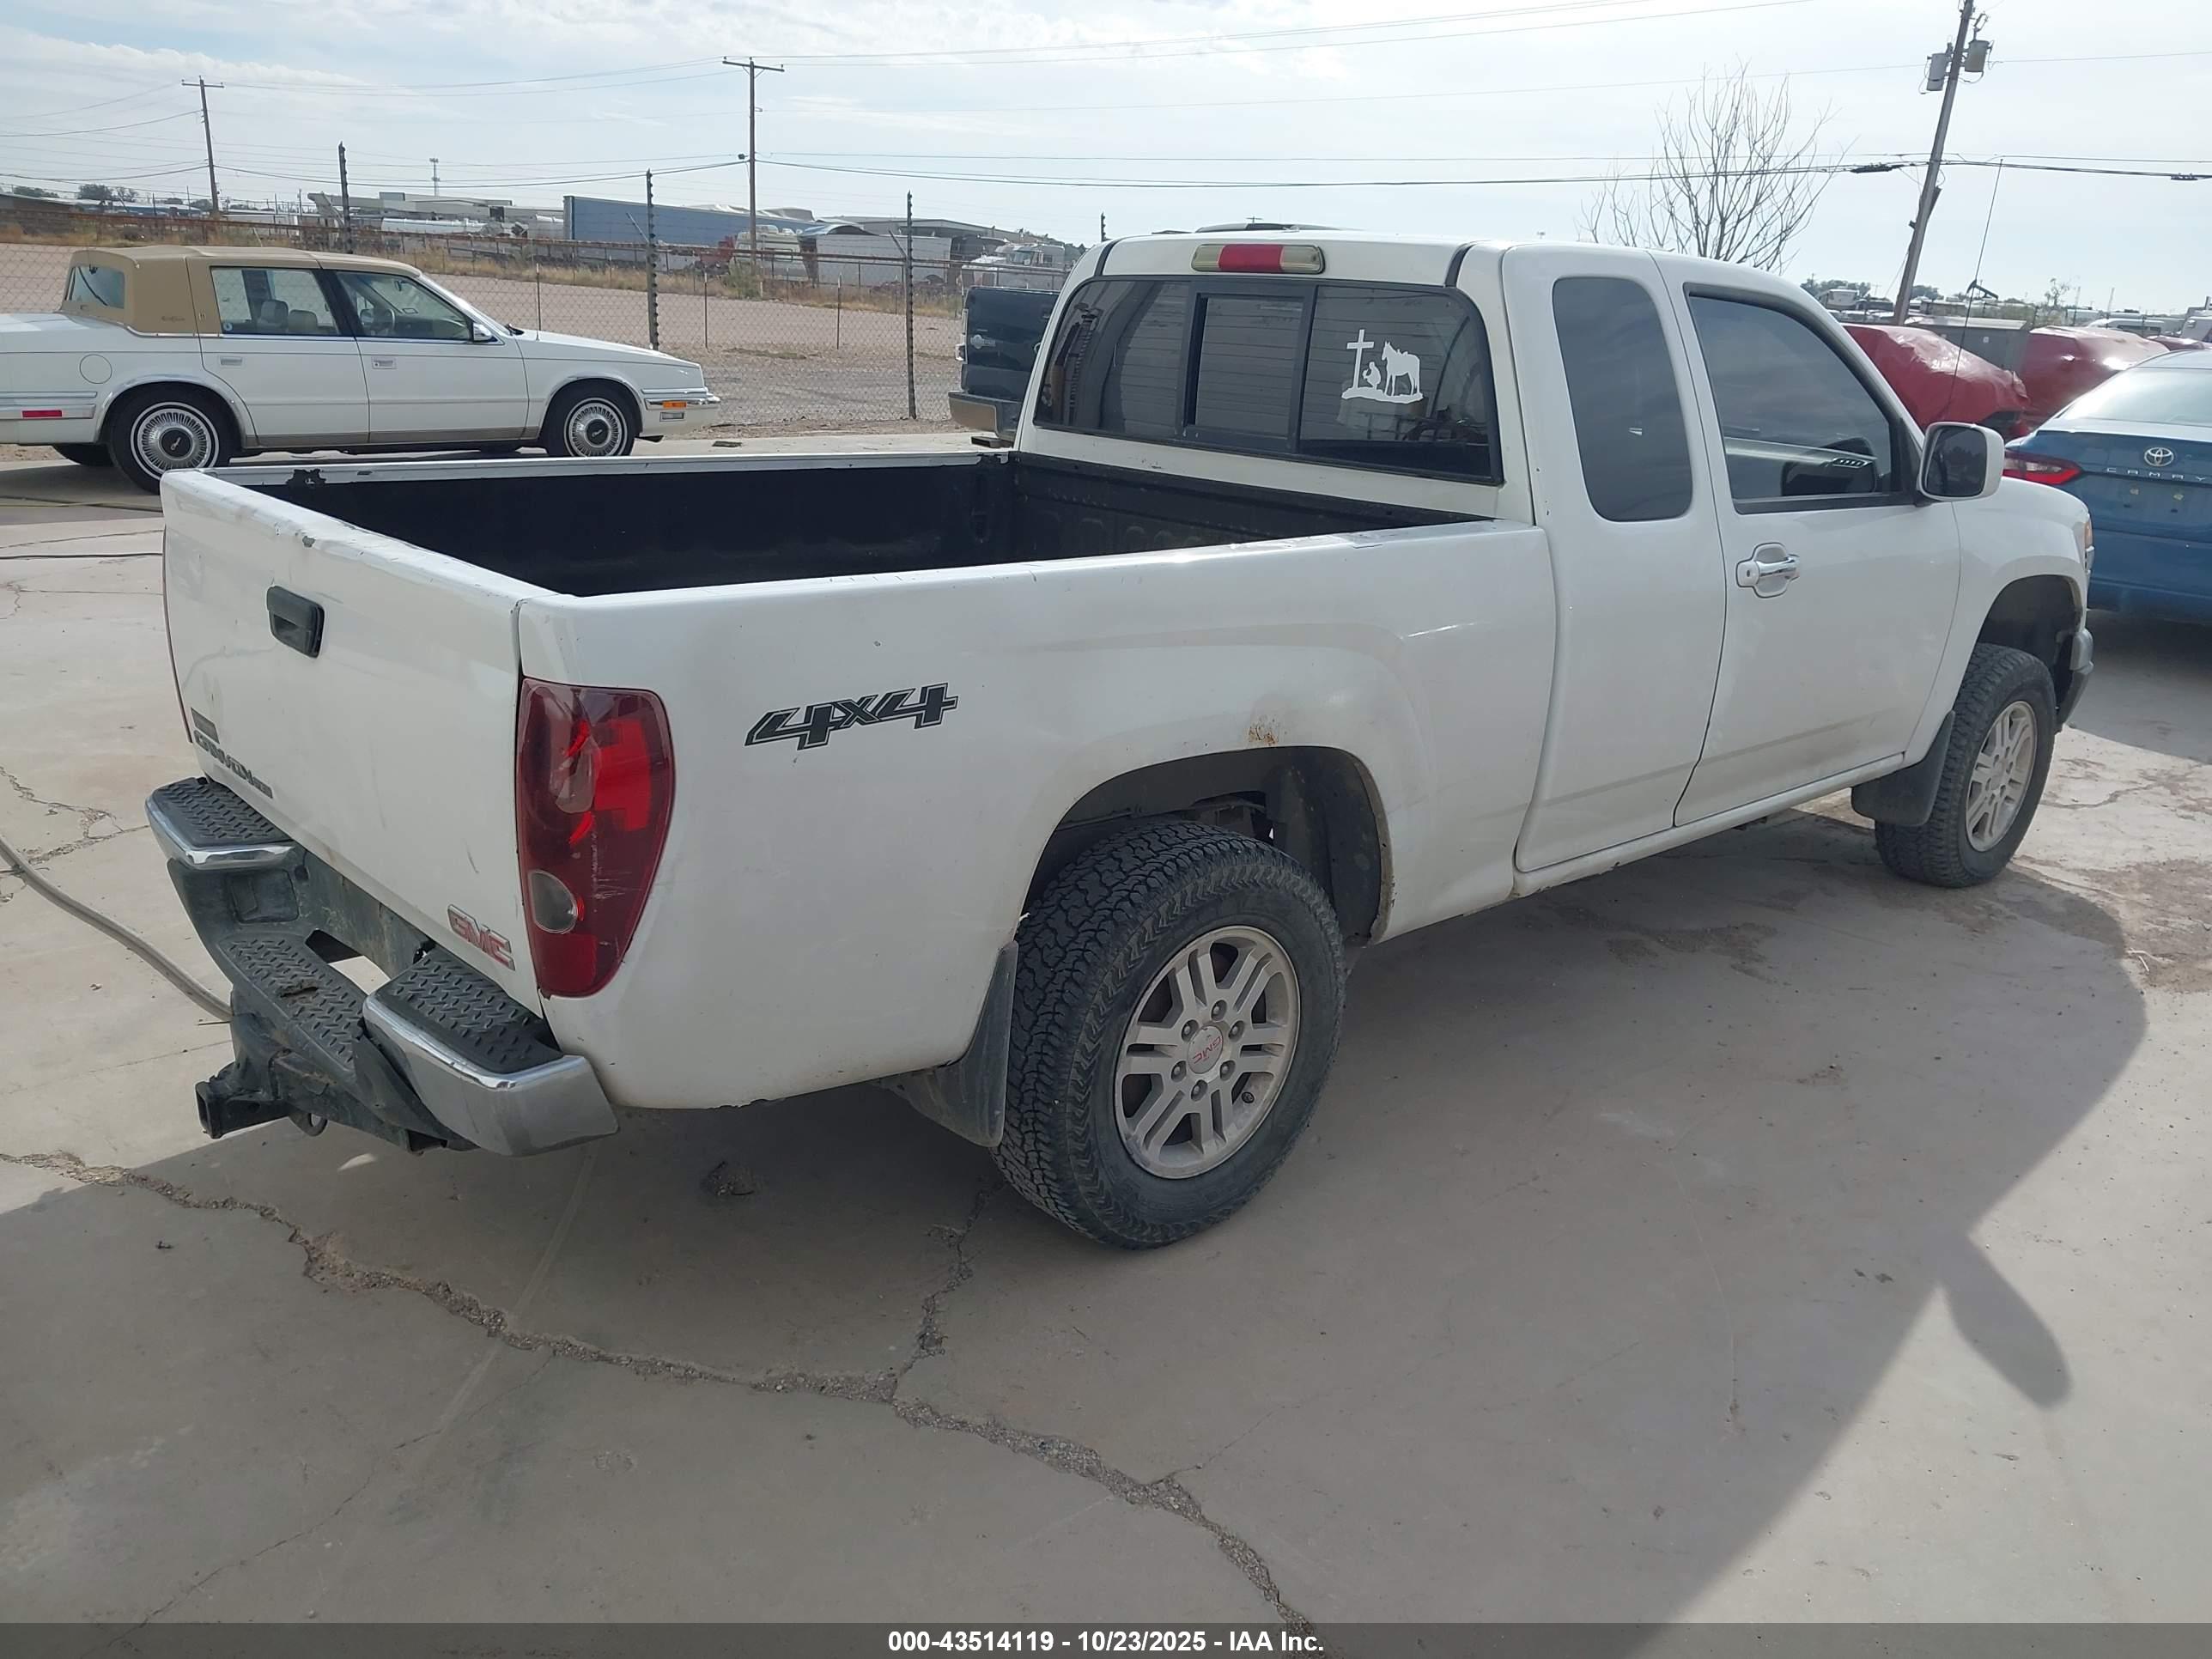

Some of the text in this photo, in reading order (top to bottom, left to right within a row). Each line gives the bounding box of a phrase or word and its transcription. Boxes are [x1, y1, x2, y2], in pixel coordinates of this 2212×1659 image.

[2106, 466, 2206, 482] CAMRY
[447, 903, 516, 972] GMC
[1192, 1036, 1223, 1065] GMC
